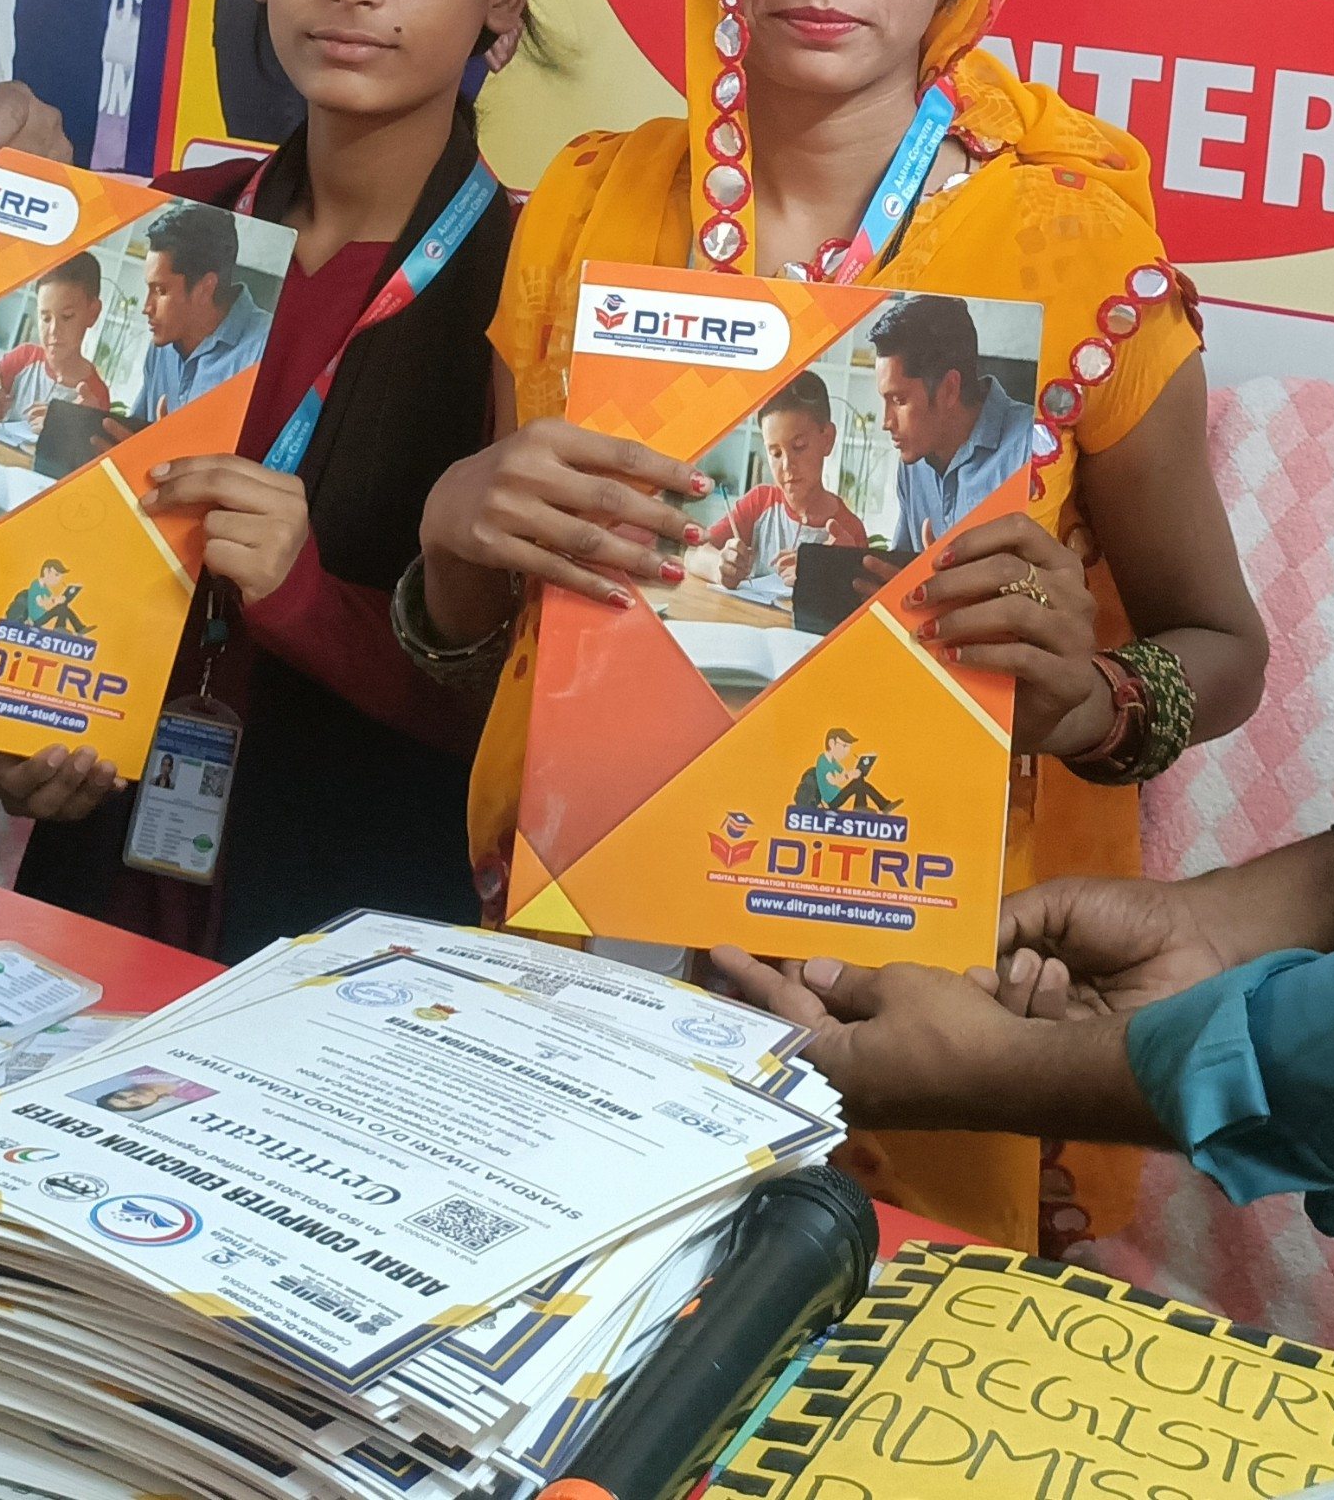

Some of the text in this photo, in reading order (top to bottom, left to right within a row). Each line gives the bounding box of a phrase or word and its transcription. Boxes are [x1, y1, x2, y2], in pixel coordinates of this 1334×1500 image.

[788, 813, 906, 841] SELF-STUDY
[709, 872, 736, 883] DIGITAL
[787, 881, 835, 894] TECHNOLOGY
[899, 893, 954, 907] PROFESSIONAL
[750, 895, 913, 926] www.ditrpself-study.com
[381, 1014, 645, 1122] AARAV COMPUTER EDUCATION CENTER
[123, 1118, 212, 1159] Organization
[163, 1045, 588, 1221] SHARDHA TIWARI D/O VINOD KUMAR TIWARI
[177, 1105, 411, 1211] Certificate
[201, 1152, 270, 1184] Certified
[8, 1098, 453, 1298] AARAV COMPUTER EDUCATION CENTER
[333, 1211, 367, 1227] ISO
[359, 1223, 389, 1237] An
[203, 1228, 284, 1268] Skill India
